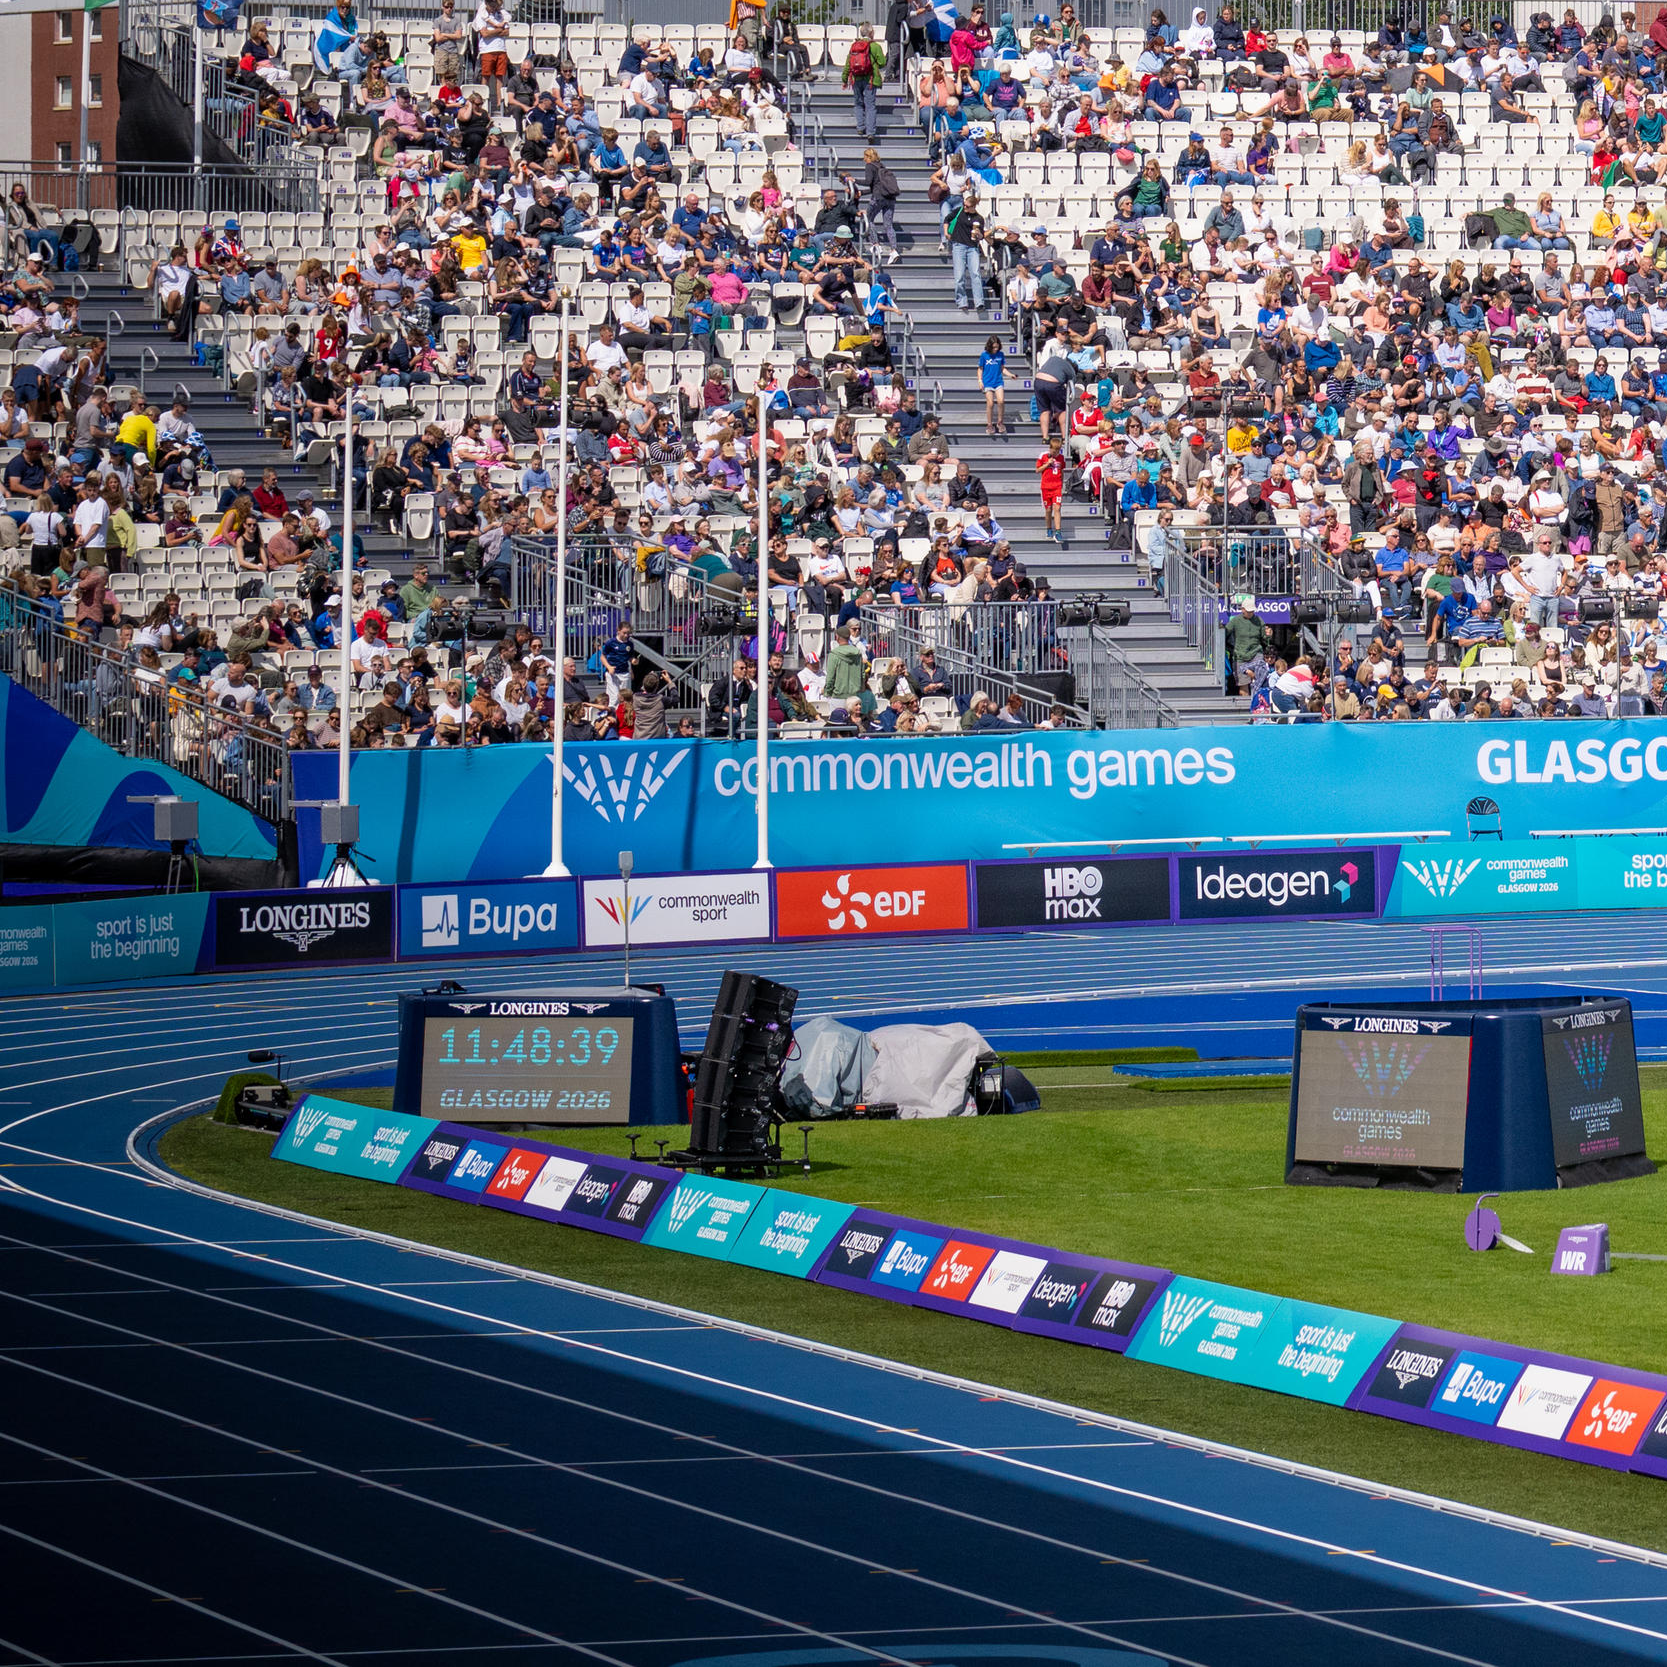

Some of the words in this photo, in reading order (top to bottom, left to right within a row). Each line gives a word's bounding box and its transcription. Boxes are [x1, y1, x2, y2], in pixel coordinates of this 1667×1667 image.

[324, 338, 333, 350] 9
[714, 742, 1052, 797] commonwealth
[1067, 745, 1236, 800] games
[1486, 854, 1570, 874] commonwealth
[1508, 868, 1548, 882] games
[1043, 865, 1104, 896] HBO
[1196, 864, 1330, 907] Ideagen
[1497, 882, 1533, 894] GLASGOW
[1535, 882, 1560, 893] 2026
[1624, 869, 1652, 889] the
[659, 890, 760, 910] commonwealth
[1044, 897, 1103, 920] max
[239, 901, 371, 933] LONGINES
[469, 896, 558, 942] Bupa
[692, 904, 728, 924] sport
[96, 916, 131, 941] sport
[135, 915, 147, 934] is
[148, 912, 174, 937] just
[91, 941, 112, 960] the
[115, 936, 180, 961] beginning
[22, 955, 39, 966] 2026
[490, 1001, 569, 1015] LONGINES
[1354, 1017, 1419, 1034] LONGINES
[1570, 1010, 1606, 1030] LONGINES
[438, 1025, 620, 1067] 11:48:39
[440, 1089, 552, 1110] GLASGOW
[556, 1089, 612, 1110] 2026
[1570, 1096, 1623, 1122] commonwealth
[1333, 1106, 1431, 1126] commonwealth
[1585, 1116, 1611, 1139] games
[374, 1126, 391, 1142] sport
[1358, 1122, 1402, 1143] games
[361, 1142, 372, 1158] the
[372, 1145, 401, 1168] beginning
[424, 1140, 457, 1161] LONGINES
[1343, 1145, 1390, 1160] GLASGOW
[468, 1153, 493, 1180] Bupa
[578, 1174, 610, 1203] Ideagen
[631, 1180, 651, 1205] HBO
[618, 1201, 640, 1221] max
[708, 1196, 751, 1215] commonwealth
[709, 1210, 732, 1225] games
[774, 1210, 796, 1229] sport
[801, 1216, 820, 1235] just
[759, 1227, 773, 1245] the
[773, 1230, 810, 1259] beginning
[840, 1229, 883, 1256] LONGINES
[901, 1246, 929, 1276] Bupa
[1560, 1250, 1587, 1271] WR
[1034, 1275, 1075, 1310] Ideagen
[1102, 1280, 1135, 1306] HBO
[1093, 1305, 1121, 1329] max
[1209, 1304, 1263, 1329] commonwealth
[1212, 1322, 1241, 1341] games
[1296, 1325, 1324, 1349] sport
[1331, 1330, 1356, 1353] just
[1197, 1340, 1222, 1358] GLASGOW
[1222, 1345, 1237, 1361] 2026
[1278, 1343, 1297, 1367] the
[1295, 1346, 1344, 1382] beginning
[1386, 1349, 1444, 1379] LONGINES
[1466, 1369, 1505, 1406] Bupa
[1538, 1389, 1579, 1408] commonwealth
